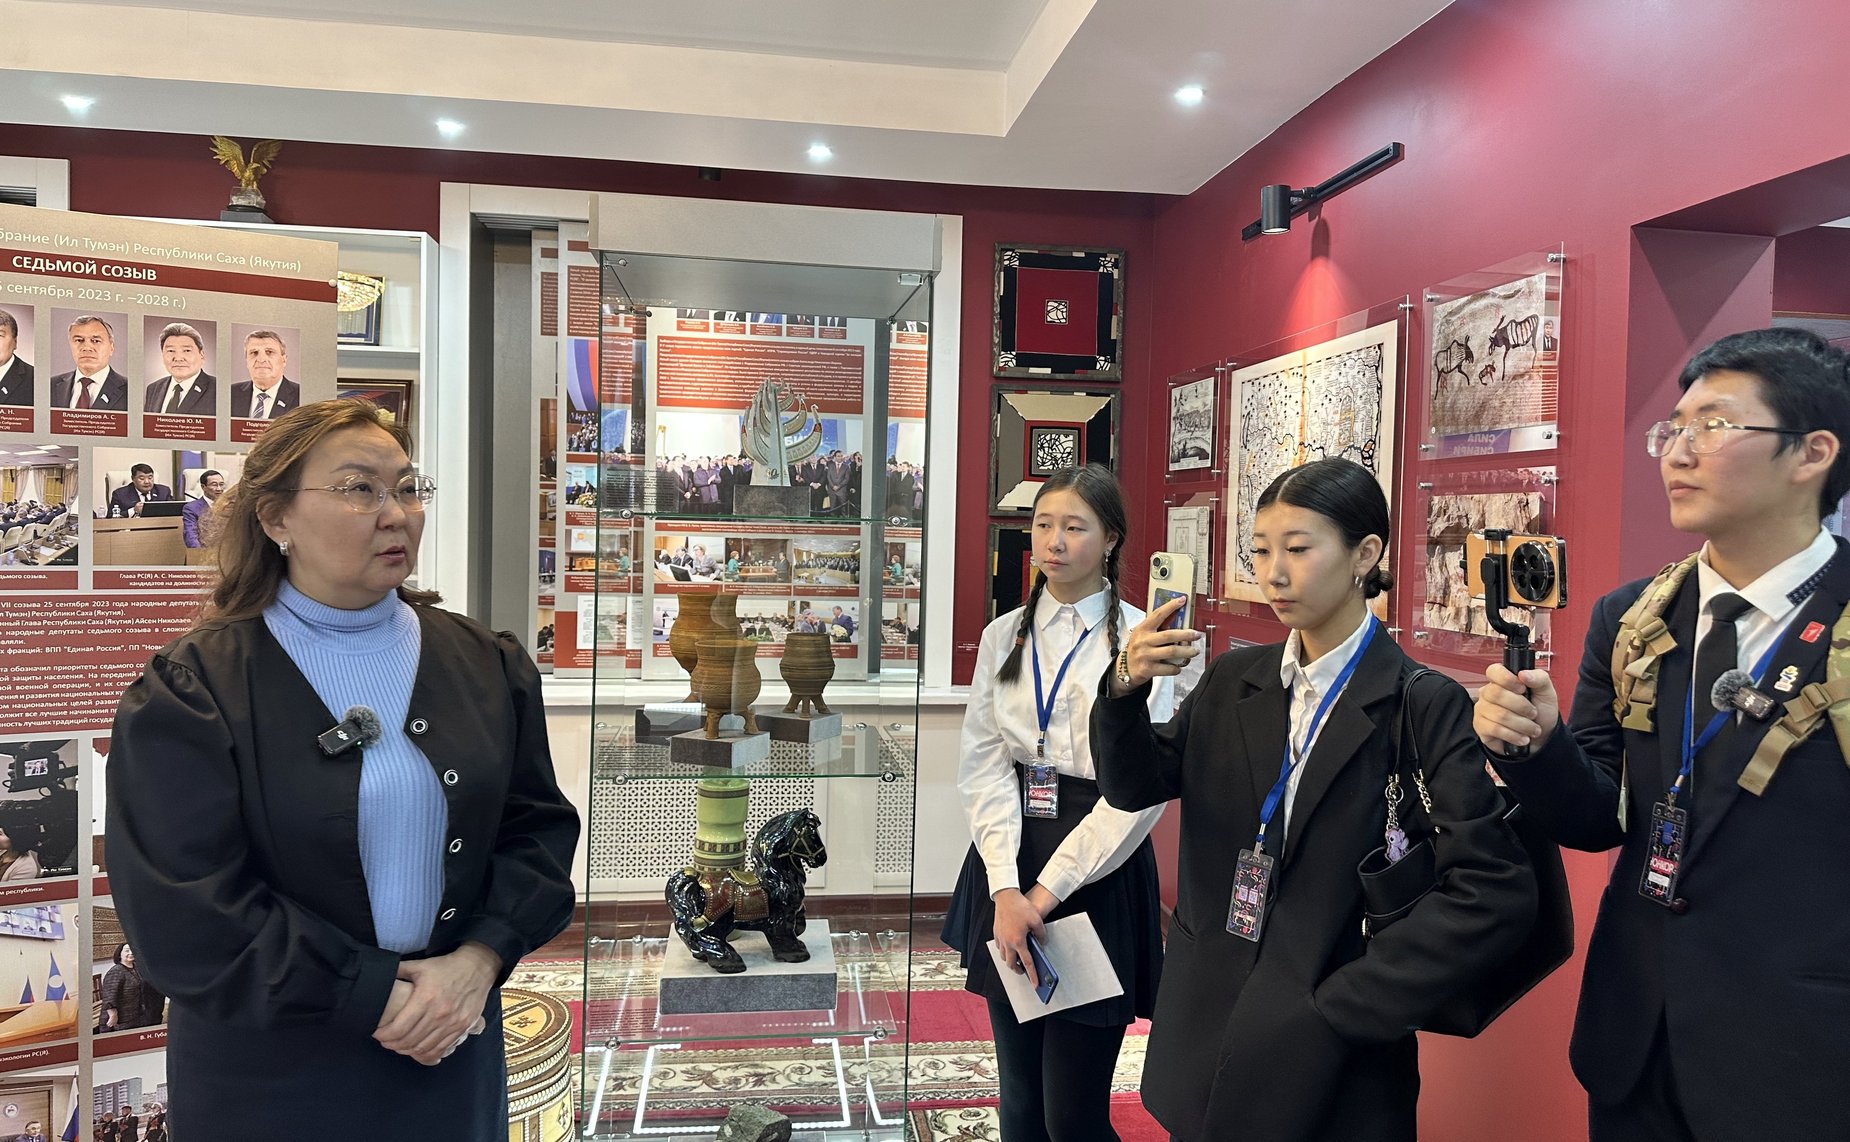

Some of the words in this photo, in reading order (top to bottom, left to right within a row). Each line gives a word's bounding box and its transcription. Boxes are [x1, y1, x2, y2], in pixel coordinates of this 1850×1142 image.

[54, 233, 79, 248] (Ил
[82, 237, 130, 255] Тумэн)
[134, 243, 213, 261] Республики
[216, 252, 246, 265] Саха
[249, 255, 301, 273] (Якутия)
[12, 255, 97, 275] СЕДЬМОЙ
[101, 264, 157, 281] СОЗЫВ
[7, 283, 74, 298] сентября
[78, 287, 112, 301] 2023
[115, 293, 124, 302] г.
[173, 297, 187, 310] г.)
[62, 411, 102, 419] Владимиров
[56, 601, 89, 609] сентября
[5, 610, 31, 618] Тумэн)
[32, 610, 75, 618] Республики
[94, 609, 126, 617] (Якутия).
[43, 619, 86, 627] Республики
[105, 618, 134, 626] (Якутия)
[7, 647, 42, 655] фракций:
[53, 664, 97, 672] приоритеты
[12, 701, 67, 709] национальных
[70, 699, 93, 707] целей
[52, 718, 88, 726] традиций
[6, 887, 44, 896] республики.
